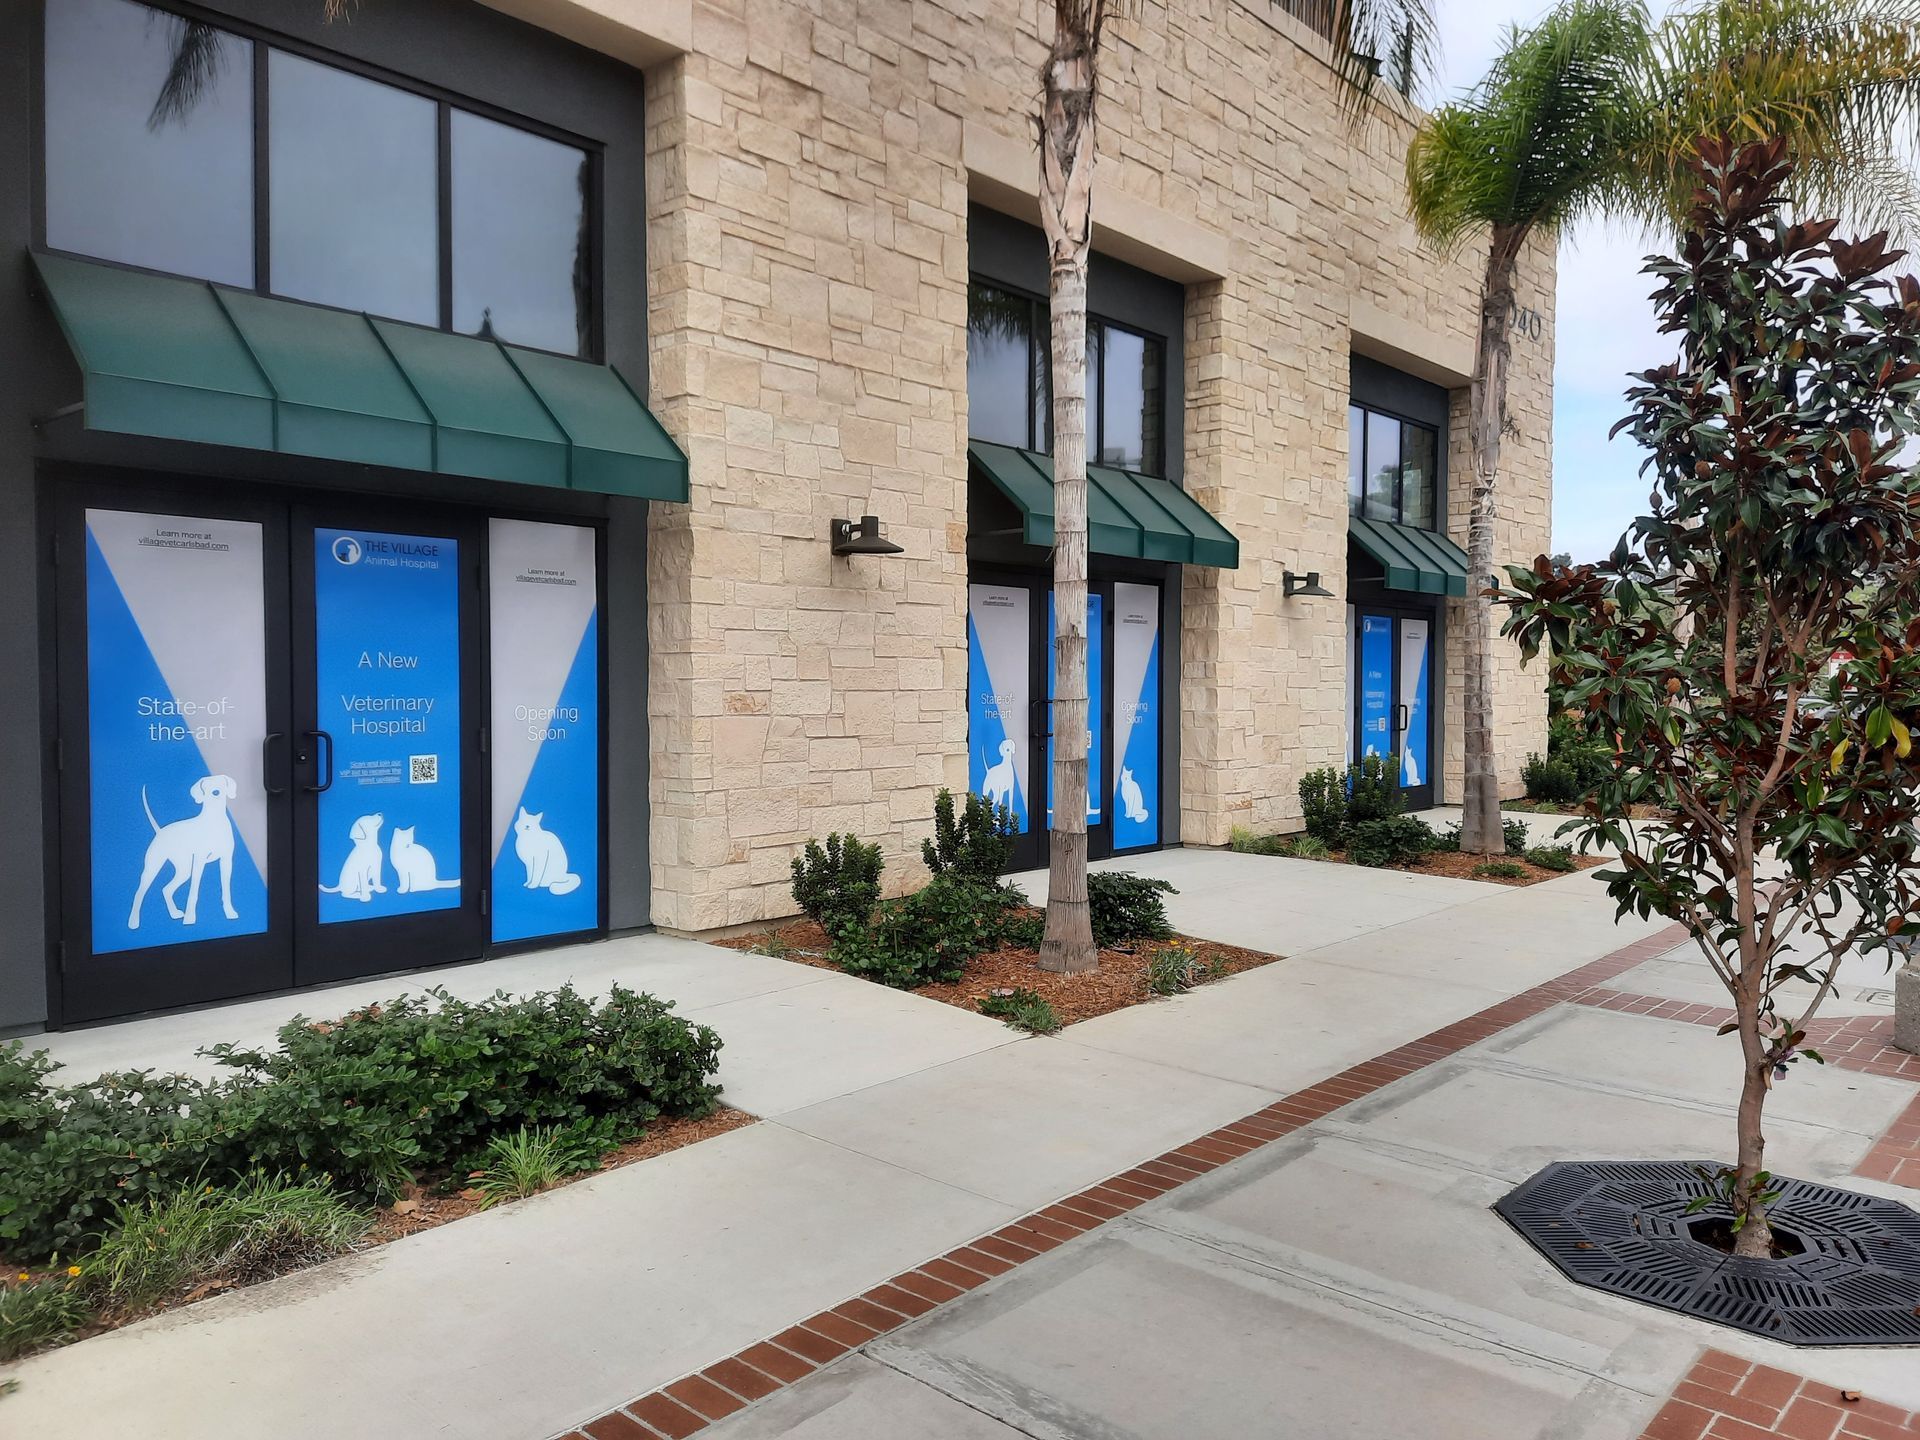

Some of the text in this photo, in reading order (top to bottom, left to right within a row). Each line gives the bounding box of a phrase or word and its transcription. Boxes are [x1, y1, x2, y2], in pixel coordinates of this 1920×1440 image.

[156, 529, 180, 537] Learn
[181, 532, 202, 540] more
[138, 537, 229, 551] villagevetcarlsbad.com
[364, 540, 440, 557] THE VILLAGE
[364, 555, 439, 569] Animal Hospital
[358, 651, 418, 669] A New
[137, 696, 235, 715] State-of-
[341, 694, 434, 714] Veterinary
[980, 693, 1015, 705] State-of-
[1121, 701, 1148, 713] Opening
[514, 705, 578, 724] Opening
[984, 708, 1012, 719] the-art
[1127, 714, 1143, 724] Soon
[148, 722, 227, 741] the-art
[351, 716, 426, 737] Hospital
[528, 725, 566, 741] Soon
